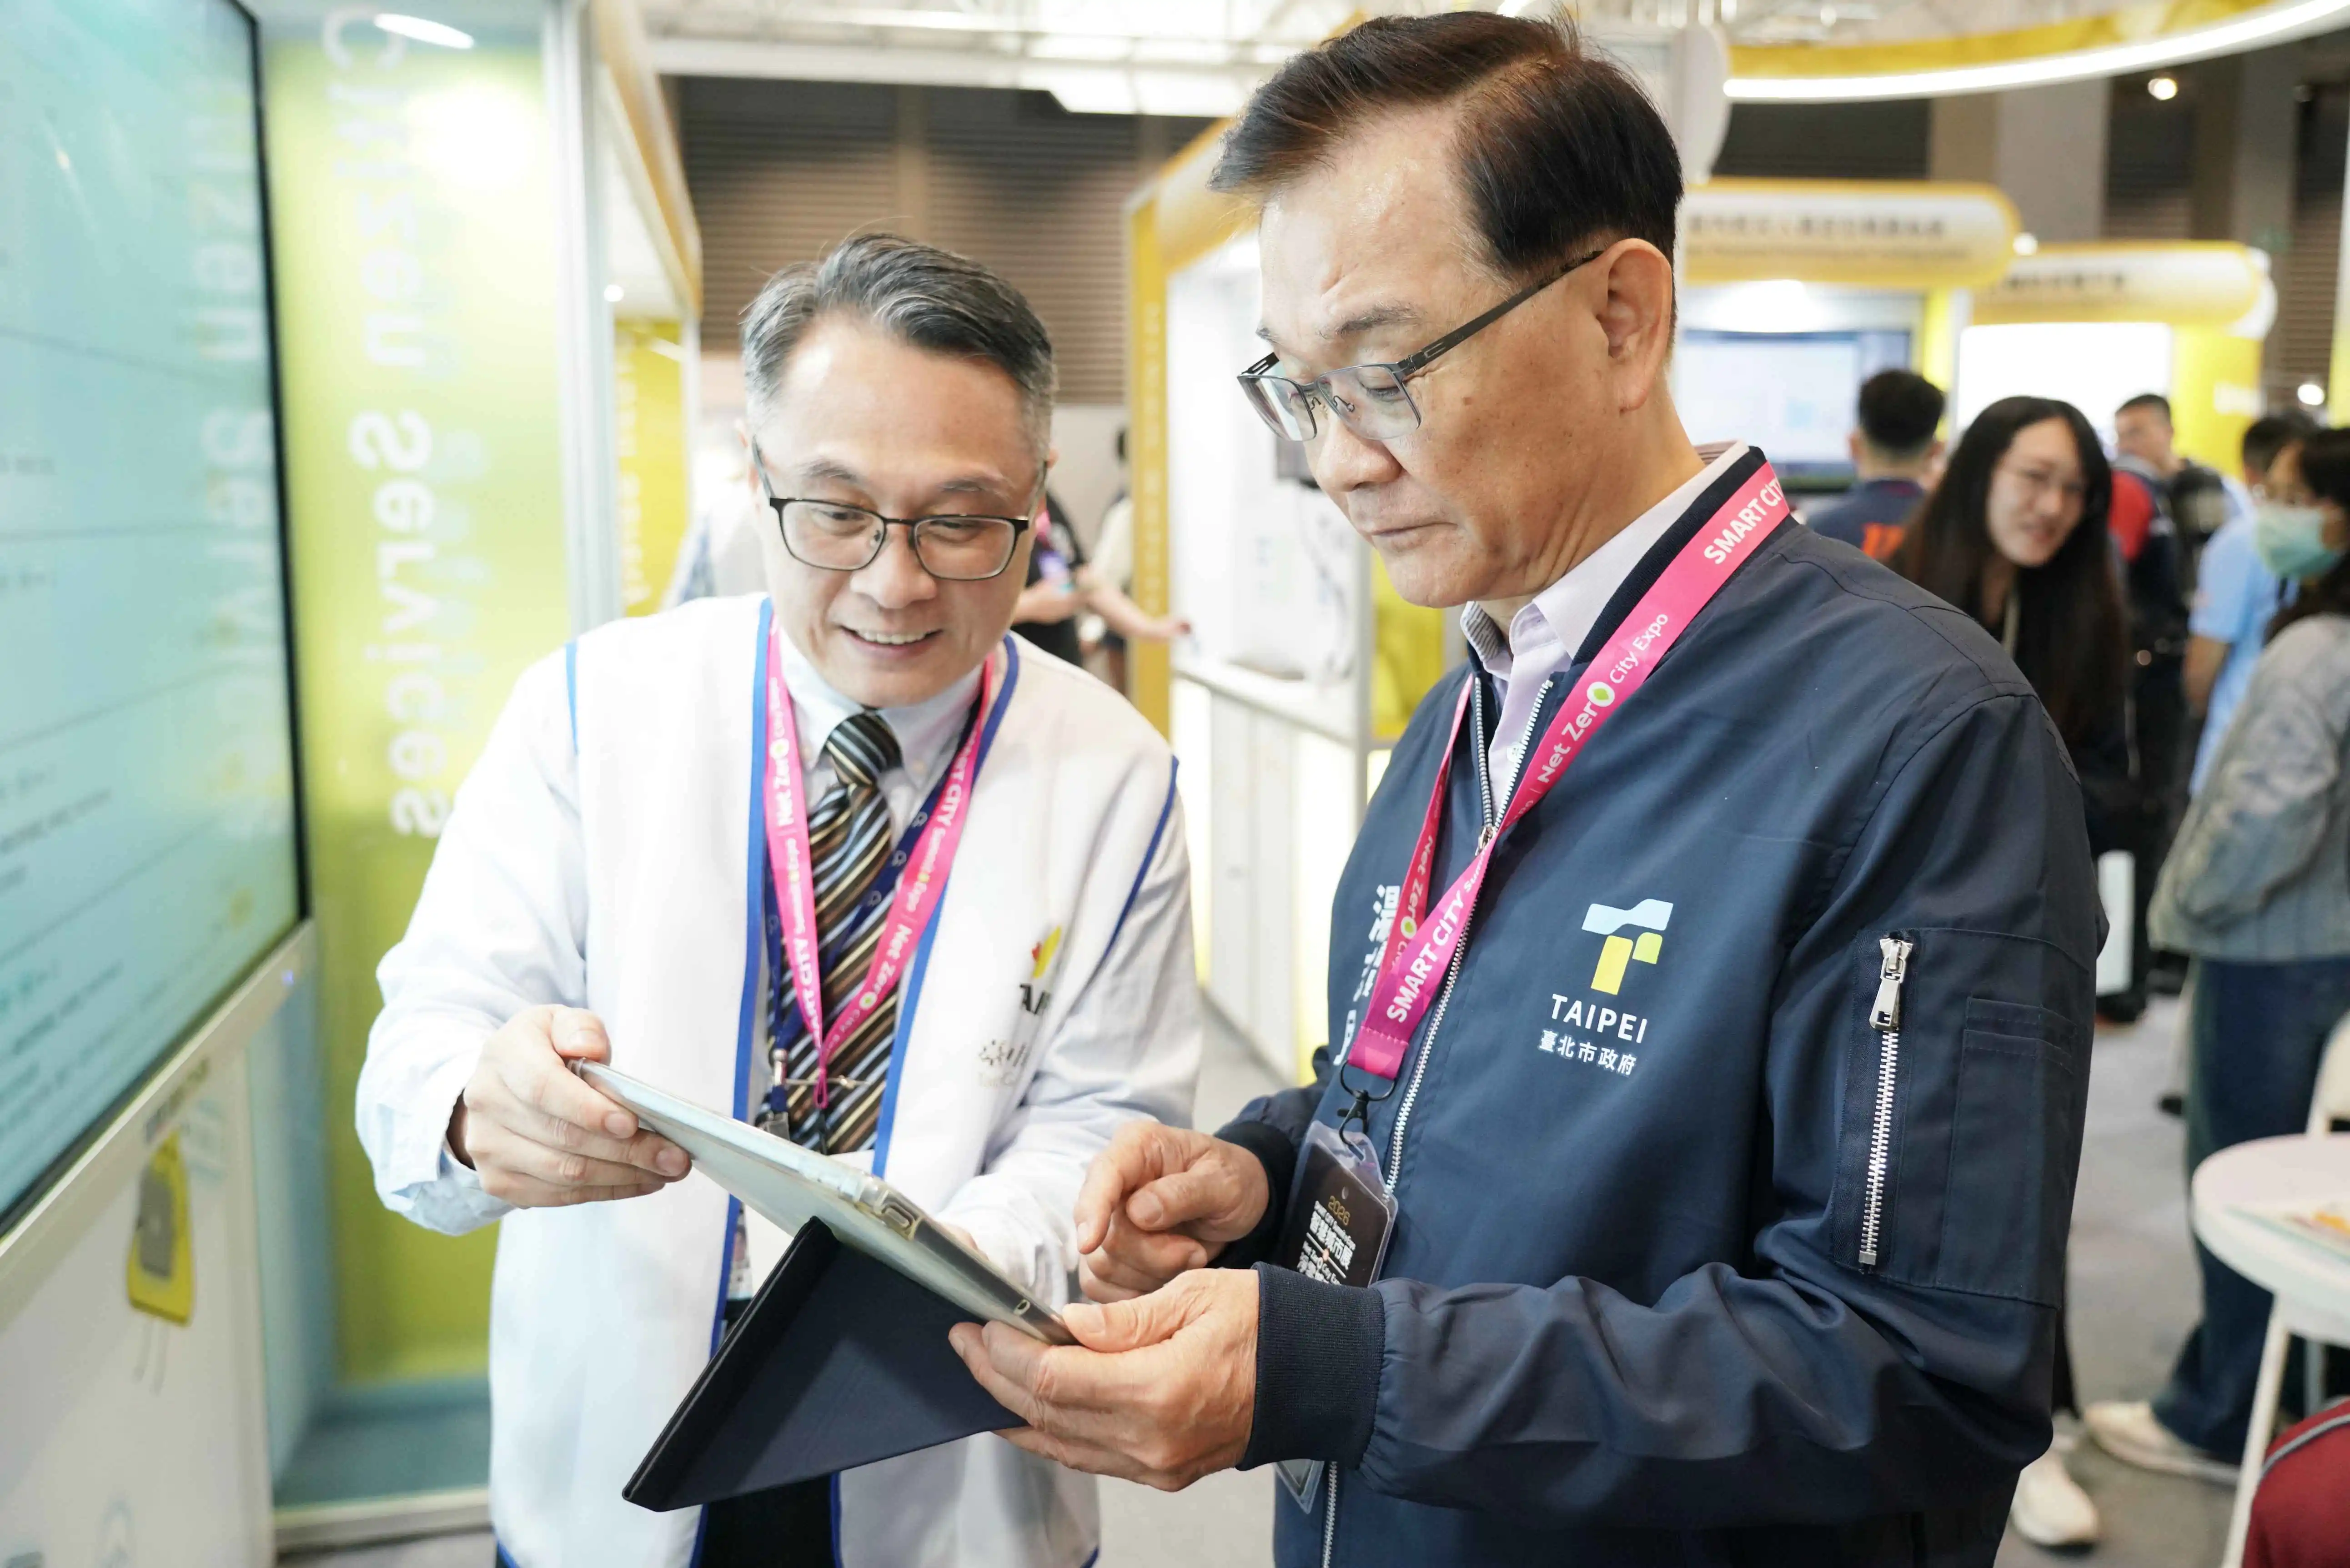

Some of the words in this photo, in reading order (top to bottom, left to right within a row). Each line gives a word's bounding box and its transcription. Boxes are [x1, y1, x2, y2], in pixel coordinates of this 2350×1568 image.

[1704, 498, 1768, 565] SMART
[1760, 478, 1784, 507] CIT
[1537, 742, 1572, 784] Net
[1609, 651, 1639, 684] City
[1632, 614, 1669, 651] Expo
[937, 784, 962, 827] CITY
[1417, 835, 1433, 876] Net
[793, 939, 813, 985] CITY
[887, 923, 913, 960] Net
[1387, 942, 1438, 1023] SMART
[1433, 890, 1464, 946] CITY
[1552, 993, 1647, 1044] TAIPEI
[1539, 1030, 1637, 1076] 臺北市政府
[1328, 1195, 1351, 1226] 2026
